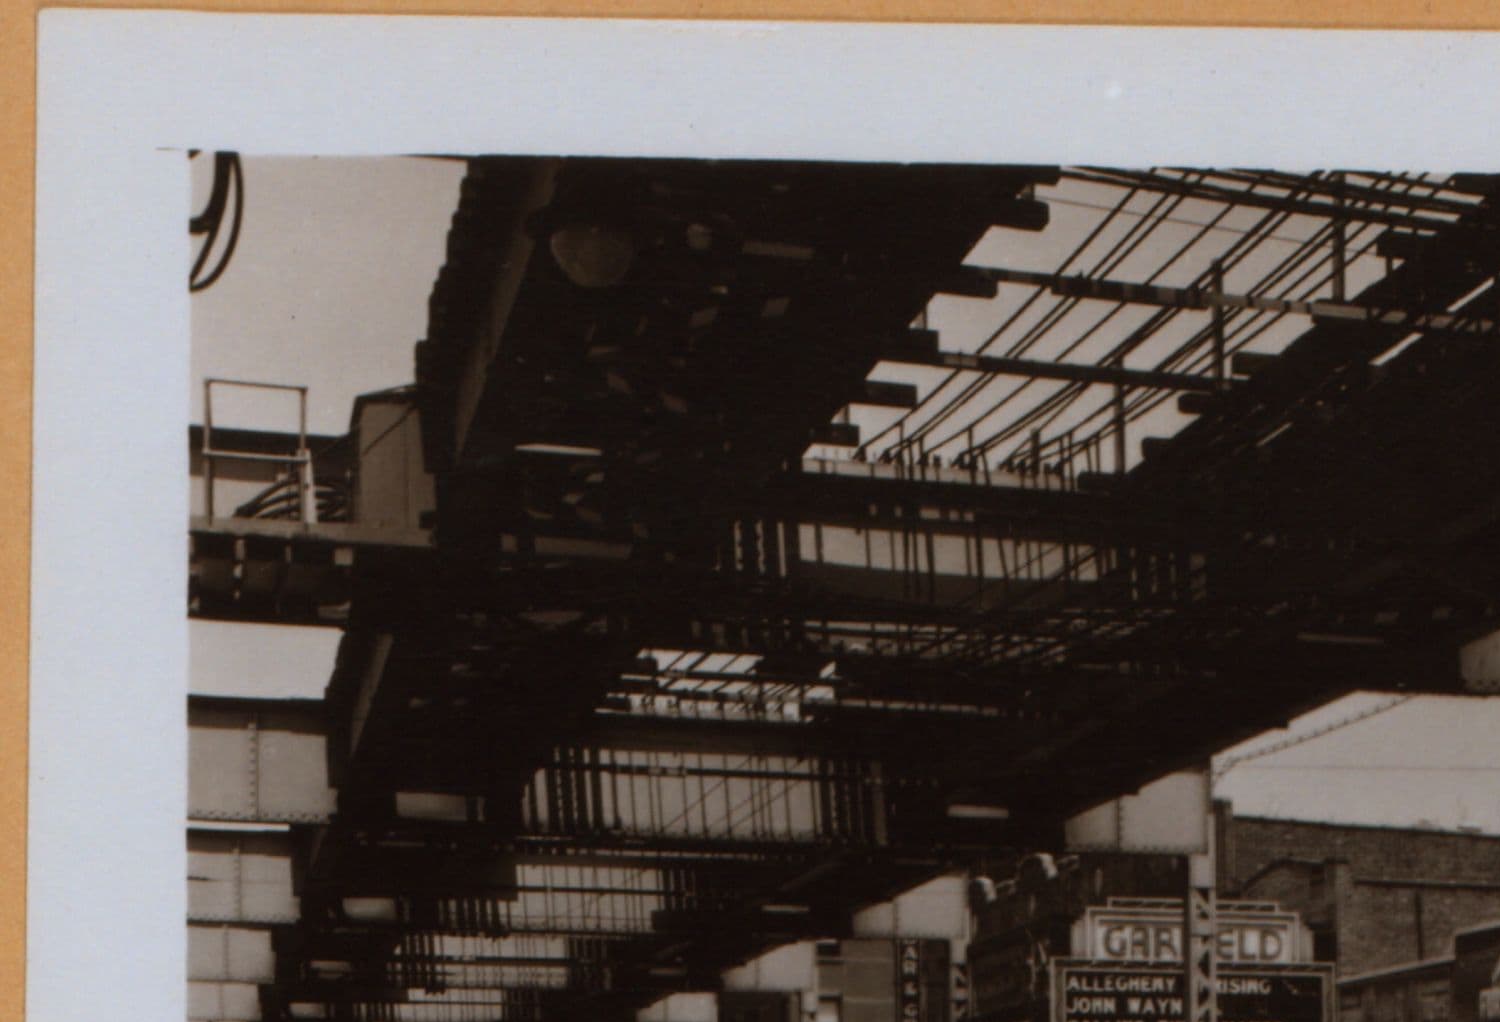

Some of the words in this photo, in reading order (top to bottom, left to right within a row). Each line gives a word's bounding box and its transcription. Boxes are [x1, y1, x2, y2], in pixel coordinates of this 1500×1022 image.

[1102, 925, 1284, 961] GARELD
[1066, 976, 1176, 993] ALLEGHENY
[1066, 997, 1117, 1015] JOHN
[1126, 998, 1184, 1015] WAYN
